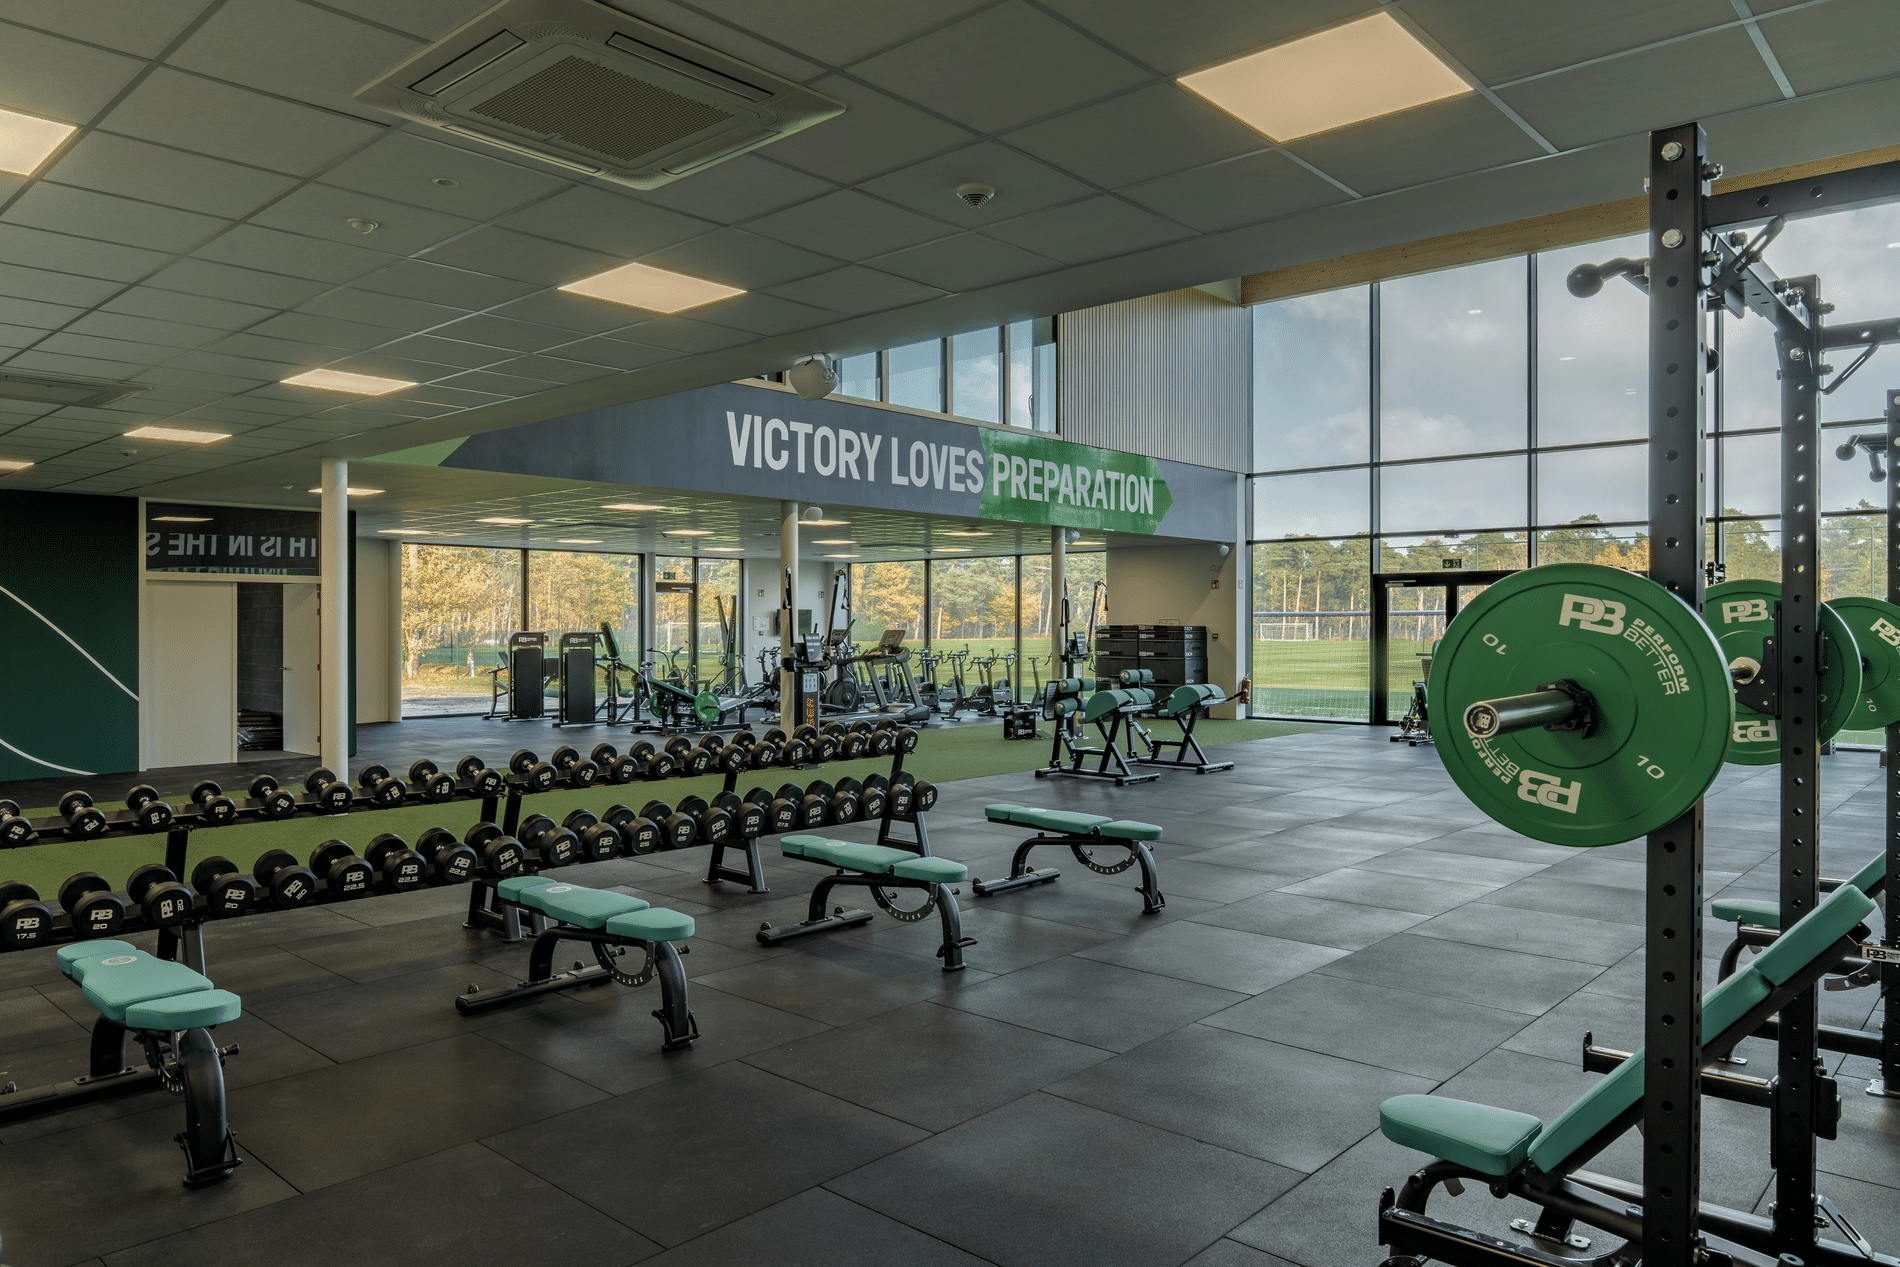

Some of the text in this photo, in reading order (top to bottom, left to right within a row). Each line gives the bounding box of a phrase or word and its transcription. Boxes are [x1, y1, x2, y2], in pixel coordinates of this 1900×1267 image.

[726, 410, 1154, 515] VICTORY LOVES PREPARATION
[1558, 593, 1627, 635] PB
[1721, 599, 1769, 624] PB
[1482, 633, 1507, 655] 10
[1632, 617, 1690, 692] PERFORM
[1622, 628, 1675, 696] BETTER
[1866, 698, 1877, 712] 10
[1468, 732, 1511, 784] PERFO
[1483, 737, 1520, 776] BETT
[1636, 754, 1665, 780] 10
[1517, 769, 1582, 814] PB
[225, 889, 246, 900] PB
[16, 918, 39, 930] PB
[90, 909, 113, 920] PB
